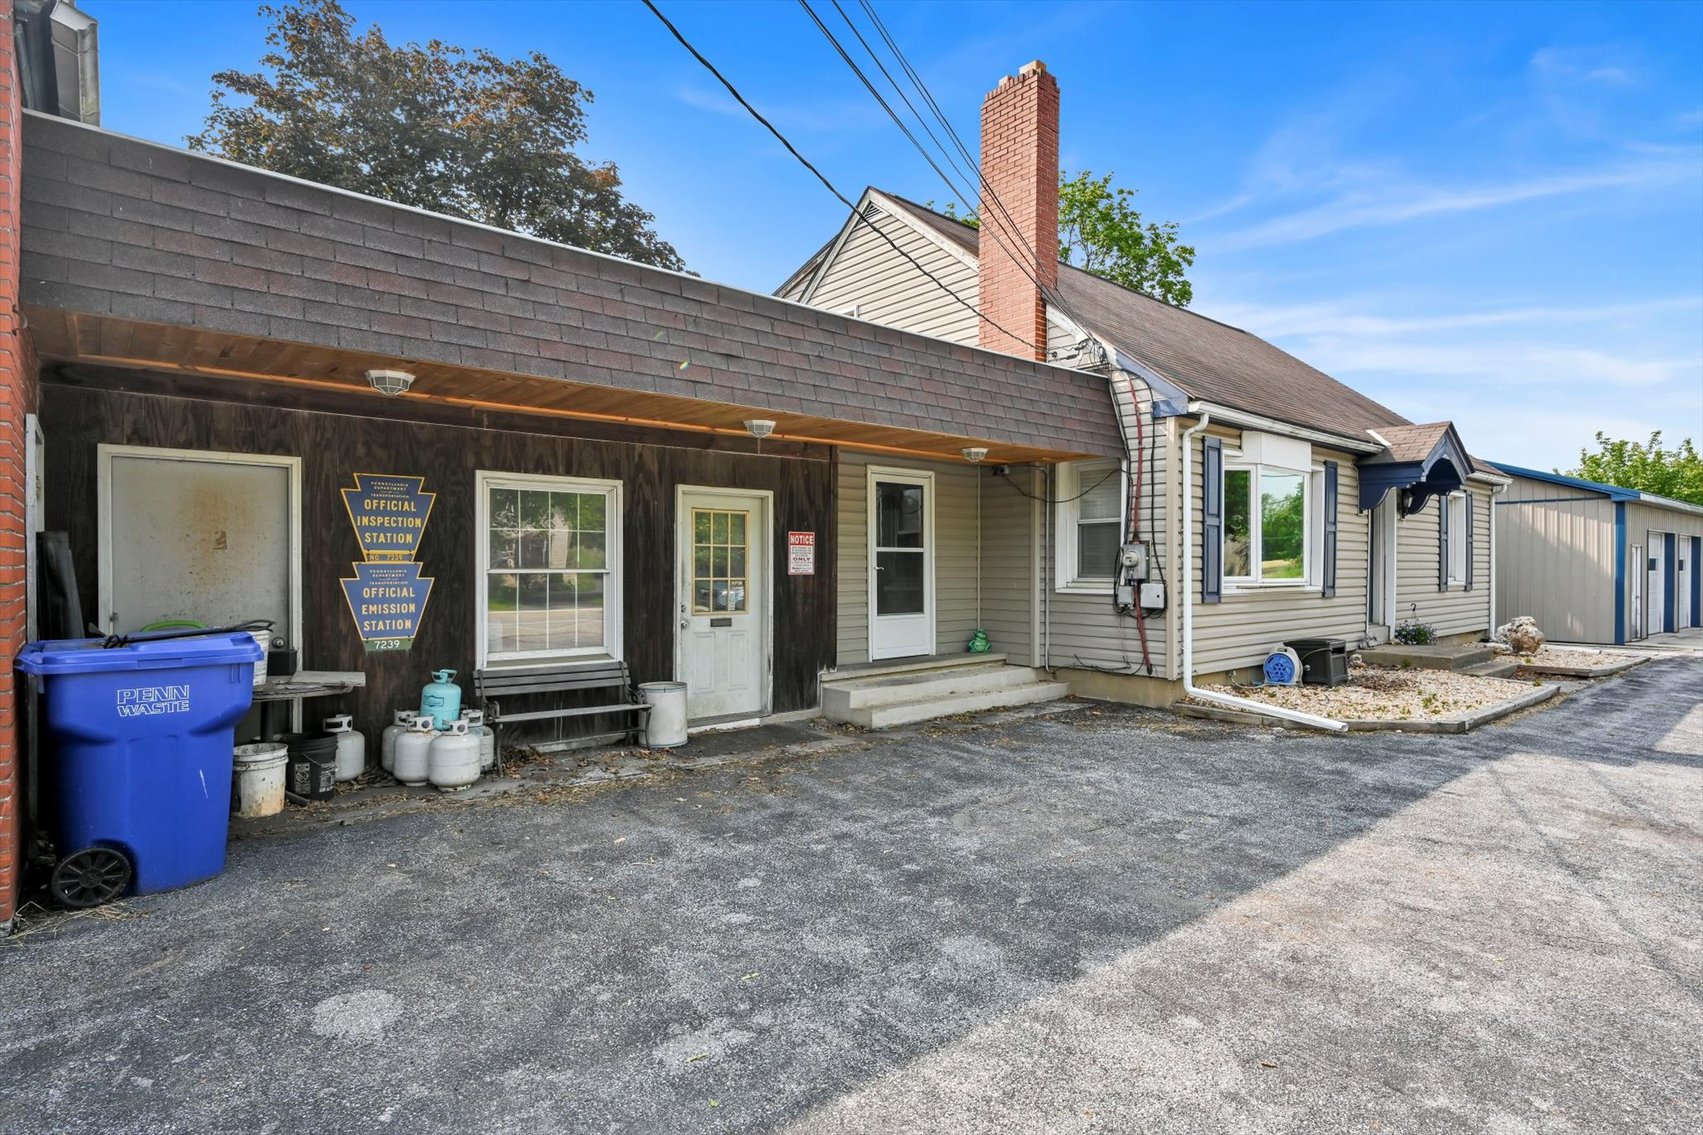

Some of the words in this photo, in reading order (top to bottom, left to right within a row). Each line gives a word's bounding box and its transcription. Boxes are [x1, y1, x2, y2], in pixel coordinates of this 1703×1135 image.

[364, 499, 416, 512] OFFICIAL
[357, 516, 422, 528] INSPECTION
[364, 532, 413, 544] STATION
[790, 535, 813, 544] NOTICE
[363, 587, 416, 599] OFFICIAL
[361, 603, 416, 615] EMISSION
[363, 619, 412, 631] STATION
[374, 640, 400, 650] 7239
[117, 685, 190, 705] PENN
[117, 700, 190, 717] WASTE
